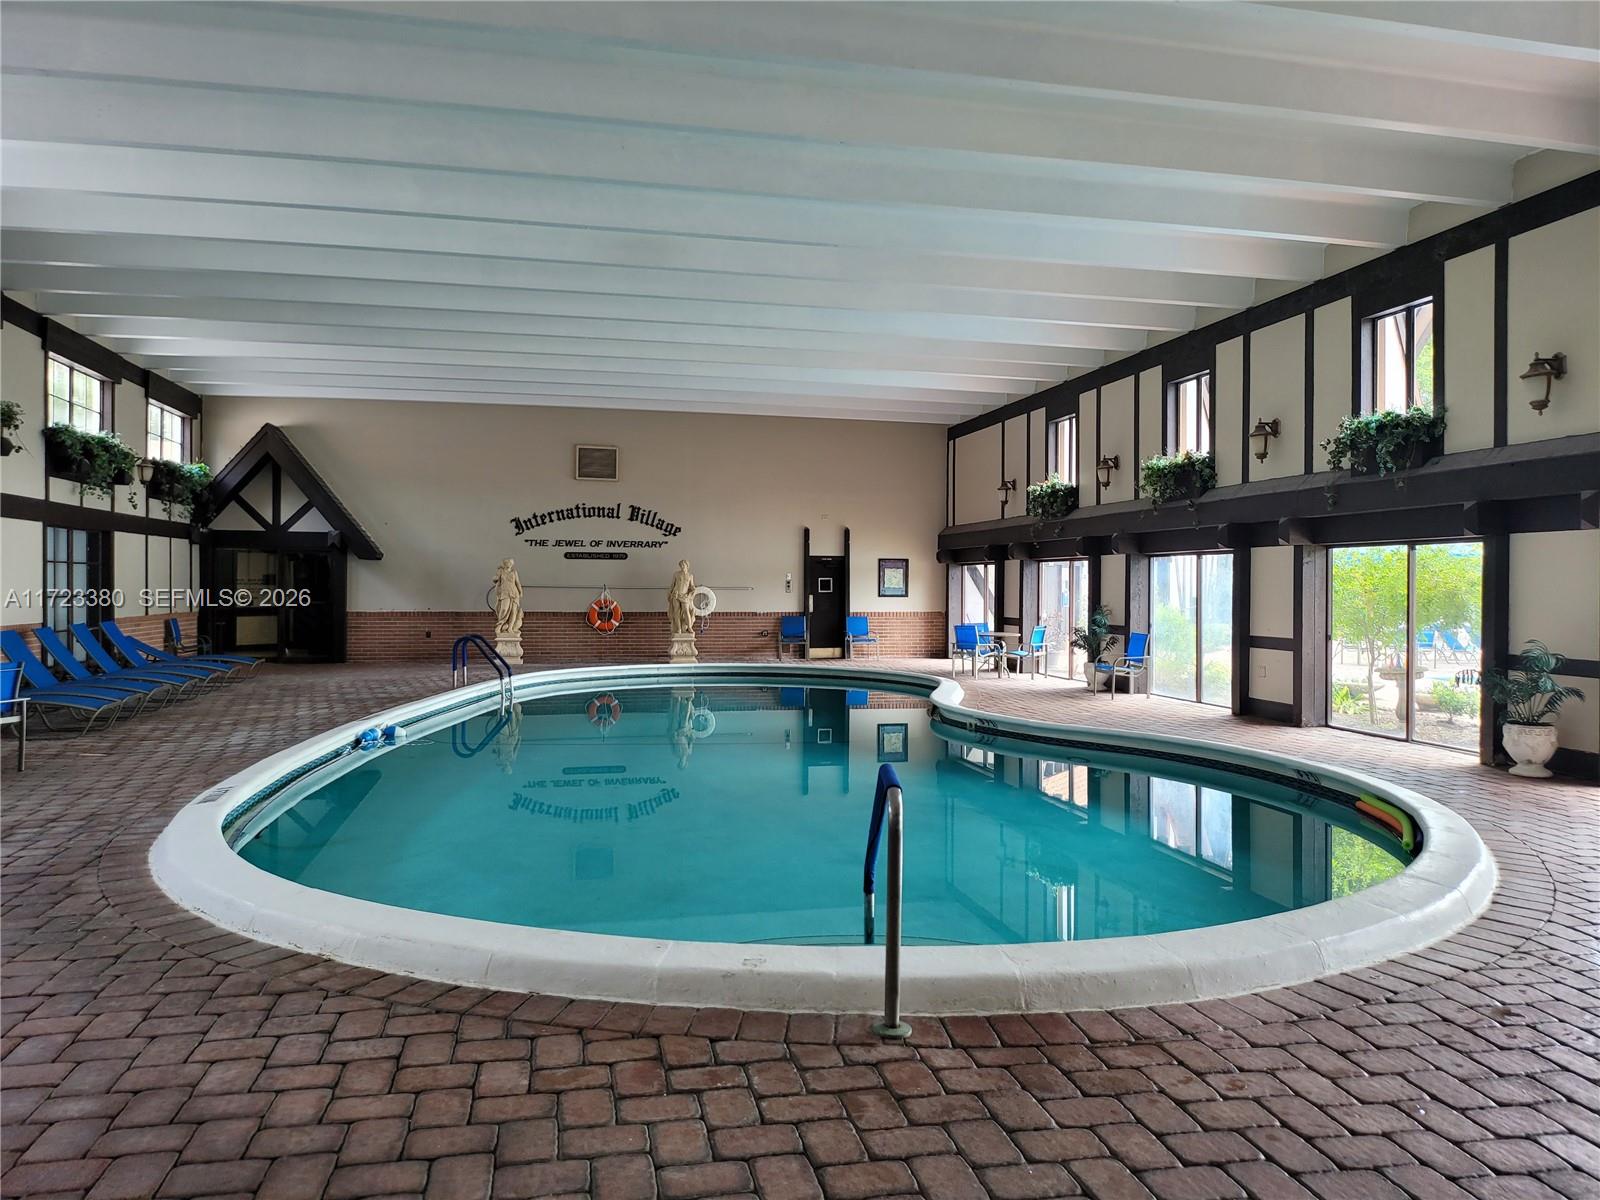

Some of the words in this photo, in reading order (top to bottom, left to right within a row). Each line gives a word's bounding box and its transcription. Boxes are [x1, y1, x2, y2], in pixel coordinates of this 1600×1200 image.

[510, 502, 621, 536] International
[628, 504, 682, 537] Village
[552, 539, 586, 547] JEWEL
[589, 540, 603, 548] OF
